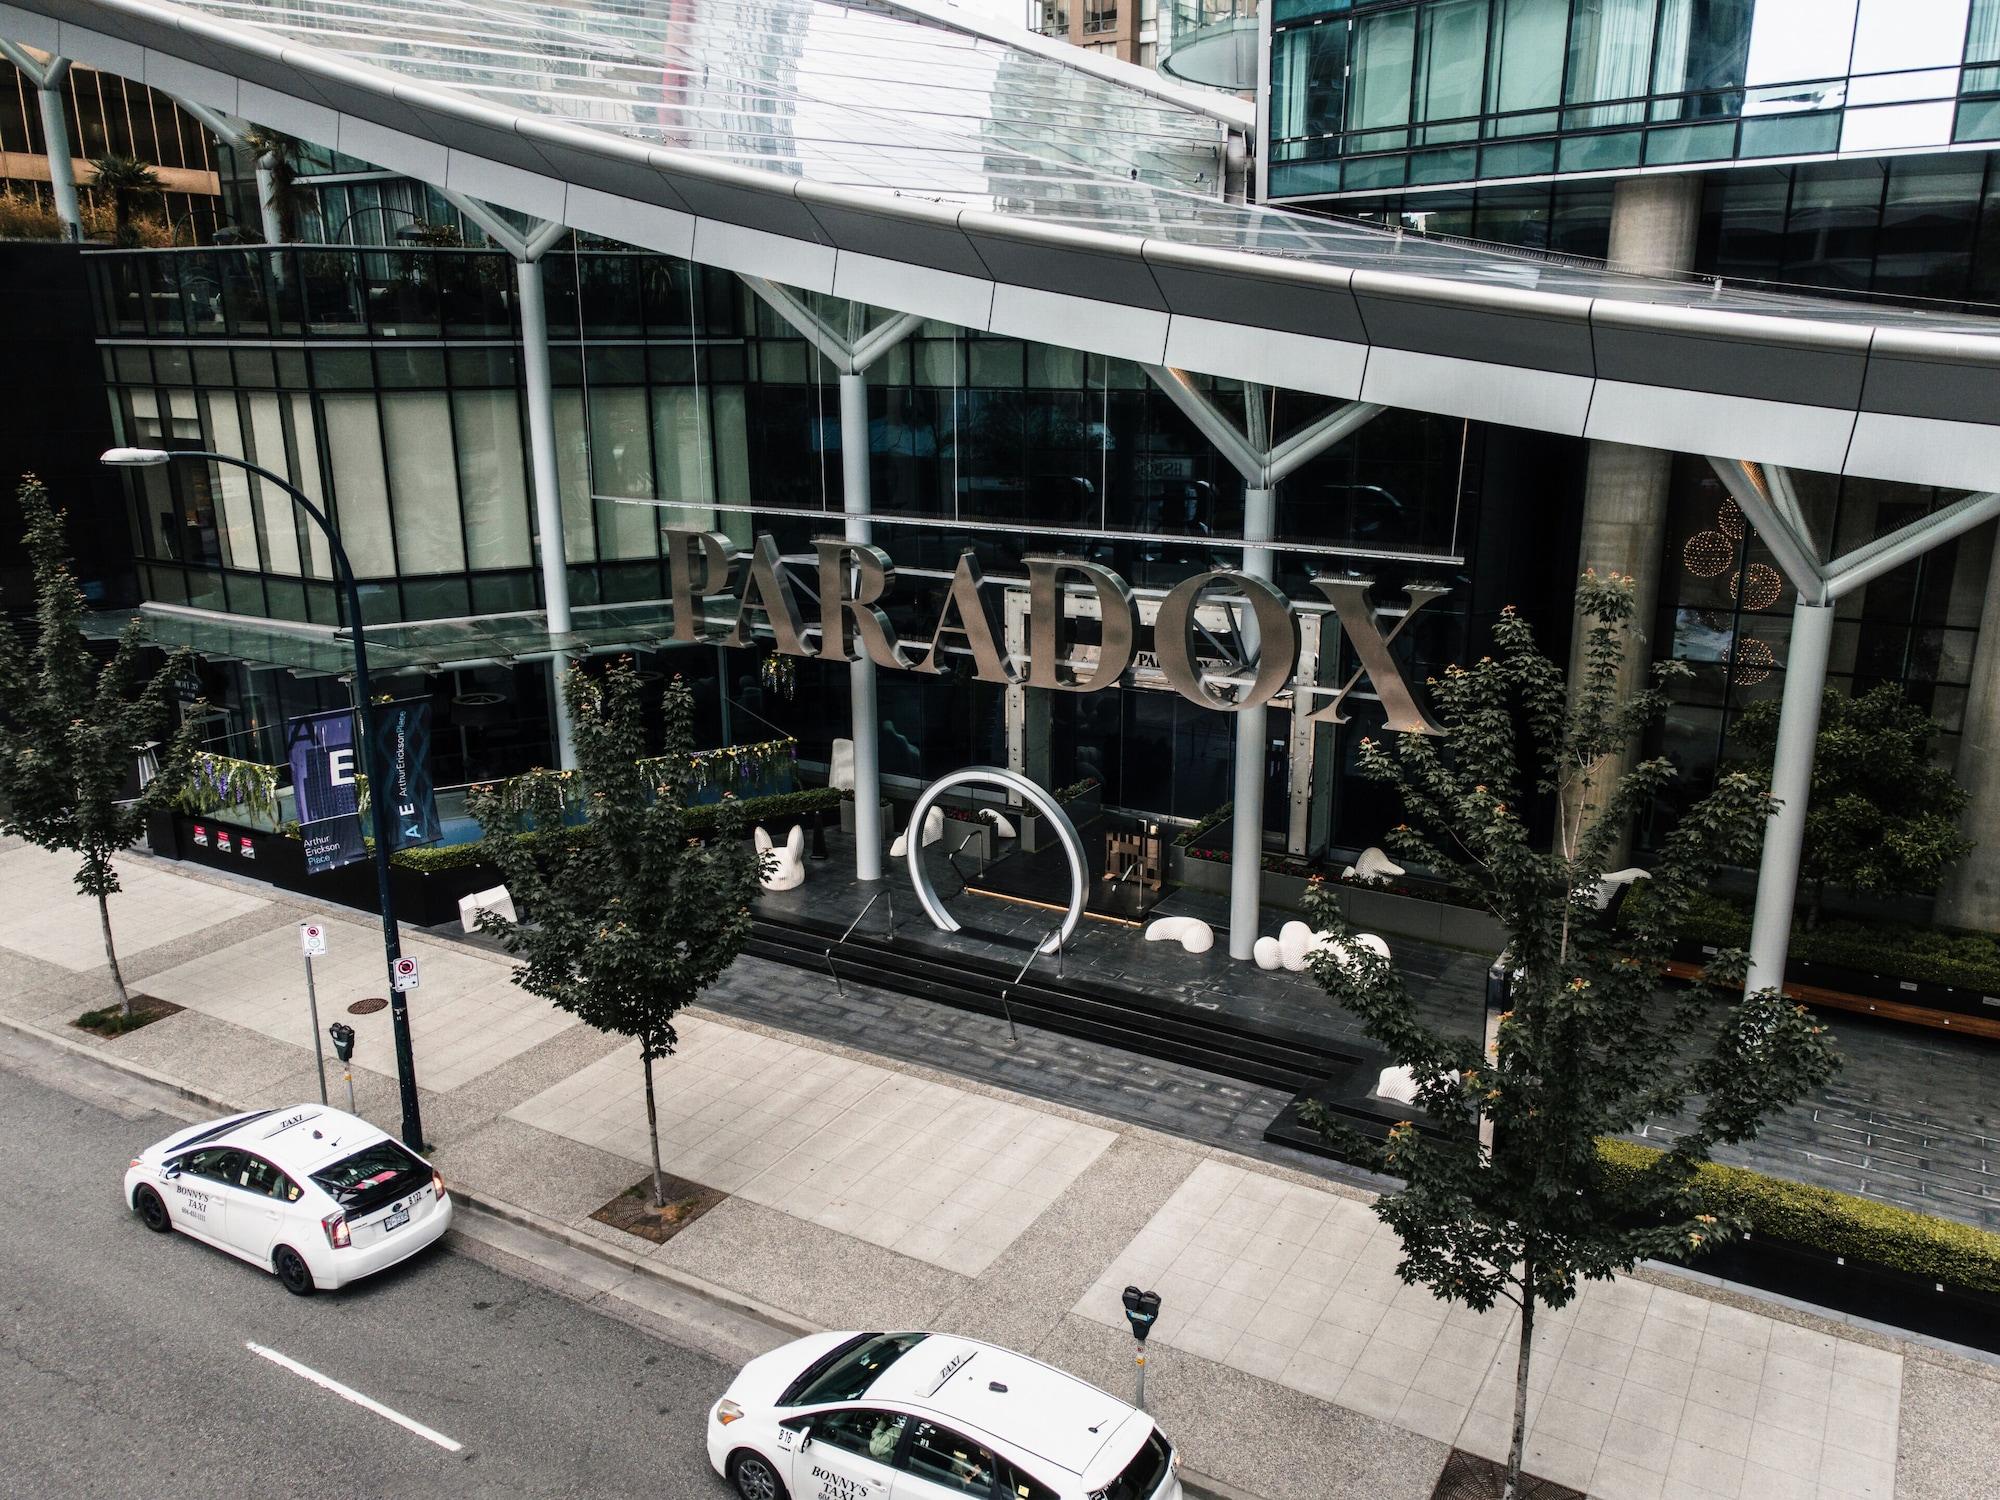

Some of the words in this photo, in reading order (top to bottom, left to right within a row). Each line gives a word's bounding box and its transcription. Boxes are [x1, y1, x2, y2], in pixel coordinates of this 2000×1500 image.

[662, 529, 1449, 736] PARADOX
[329, 749, 356, 787] E
[399, 803, 415, 816] E
[405, 824, 422, 839] A
[303, 835, 331, 848] Arthur
[305, 843, 340, 857] Erickson
[308, 854, 331, 865] Place
[281, 1114, 304, 1128] TAXI
[176, 1185, 209, 1202] BONNY'S
[188, 1199, 207, 1213] TAXI
[939, 1355, 961, 1379] TAXI
[778, 1429, 784, 1440] B
[784, 1431, 793, 1443] 16
[811, 1465, 869, 1497] BONNY'S
[823, 1482, 855, 1500] TAXI
